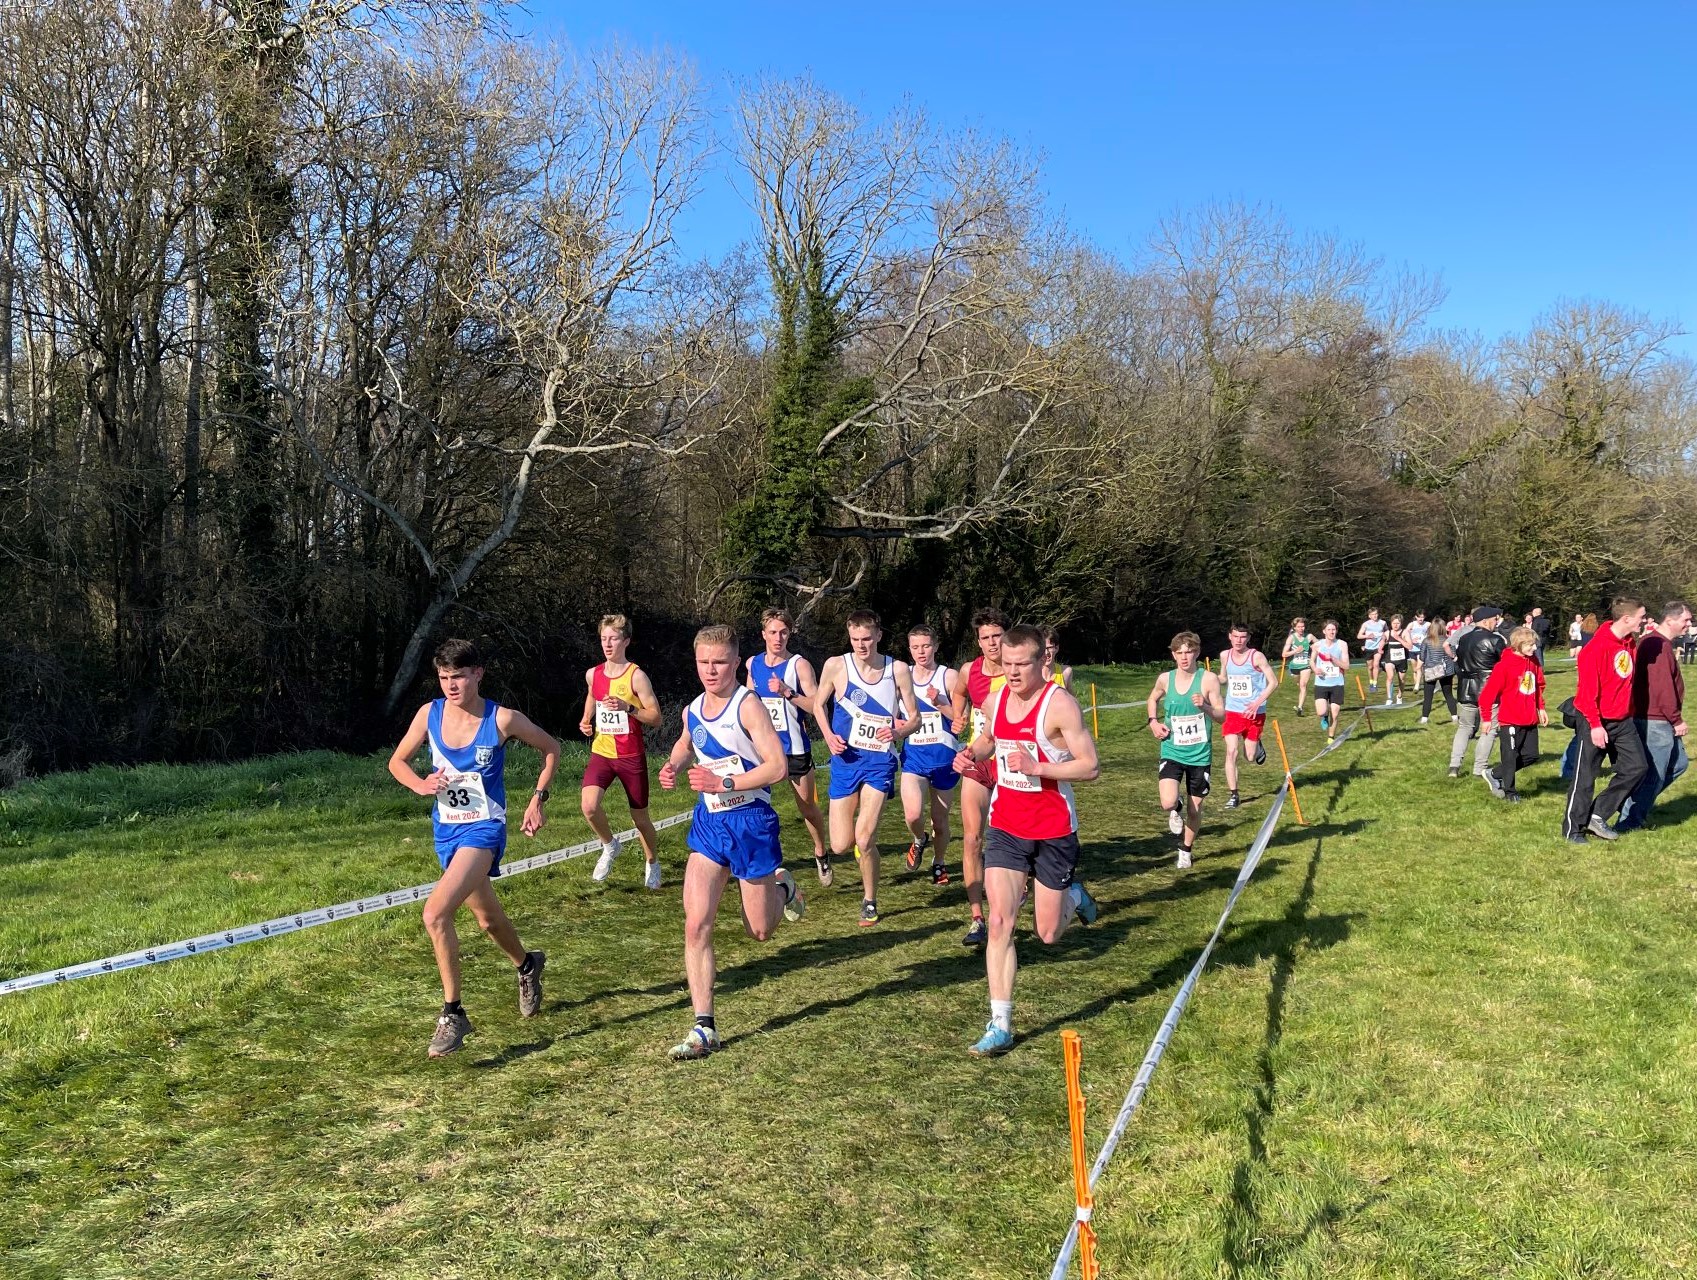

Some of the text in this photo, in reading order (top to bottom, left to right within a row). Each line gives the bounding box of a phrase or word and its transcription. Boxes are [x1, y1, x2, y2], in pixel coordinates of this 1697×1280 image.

[1232, 682, 1248, 691] 259
[601, 711, 620, 724] 321
[914, 722, 935, 735] 11
[1178, 724, 1198, 736] 141
[868, 743, 883, 751] 2022
[1002, 778, 1034, 789] Kent 2022
[447, 788, 470, 808] 33
[711, 794, 746, 810] Kent 2022
[446, 811, 481, 821] Kent 2022
